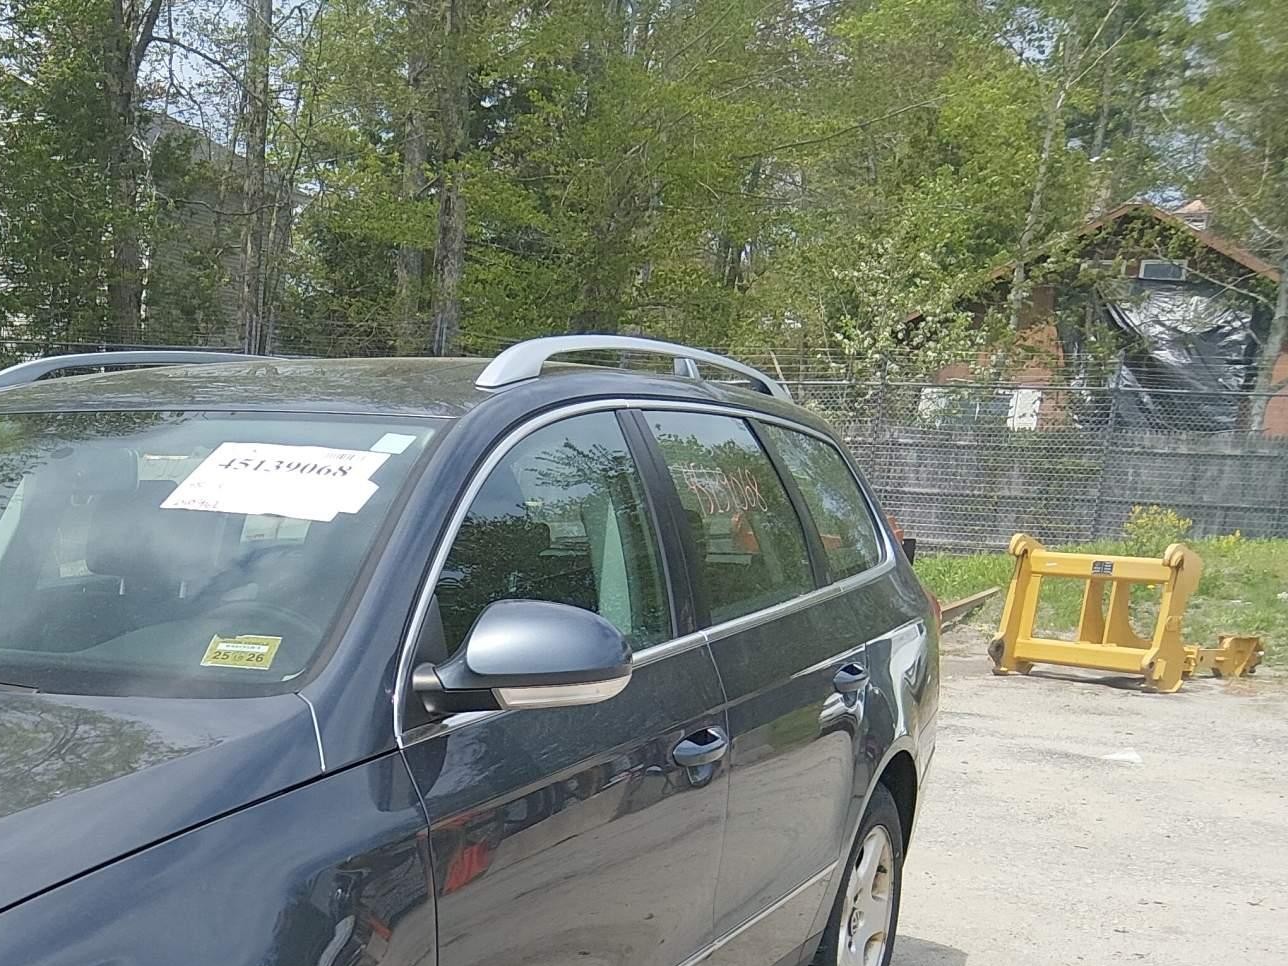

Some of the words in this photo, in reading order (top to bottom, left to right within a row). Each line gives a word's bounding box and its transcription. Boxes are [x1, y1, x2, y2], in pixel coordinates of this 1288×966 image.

[219, 458, 353, 477] 45139068
[211, 651, 231, 660] 25
[246, 653, 265, 662] 26
